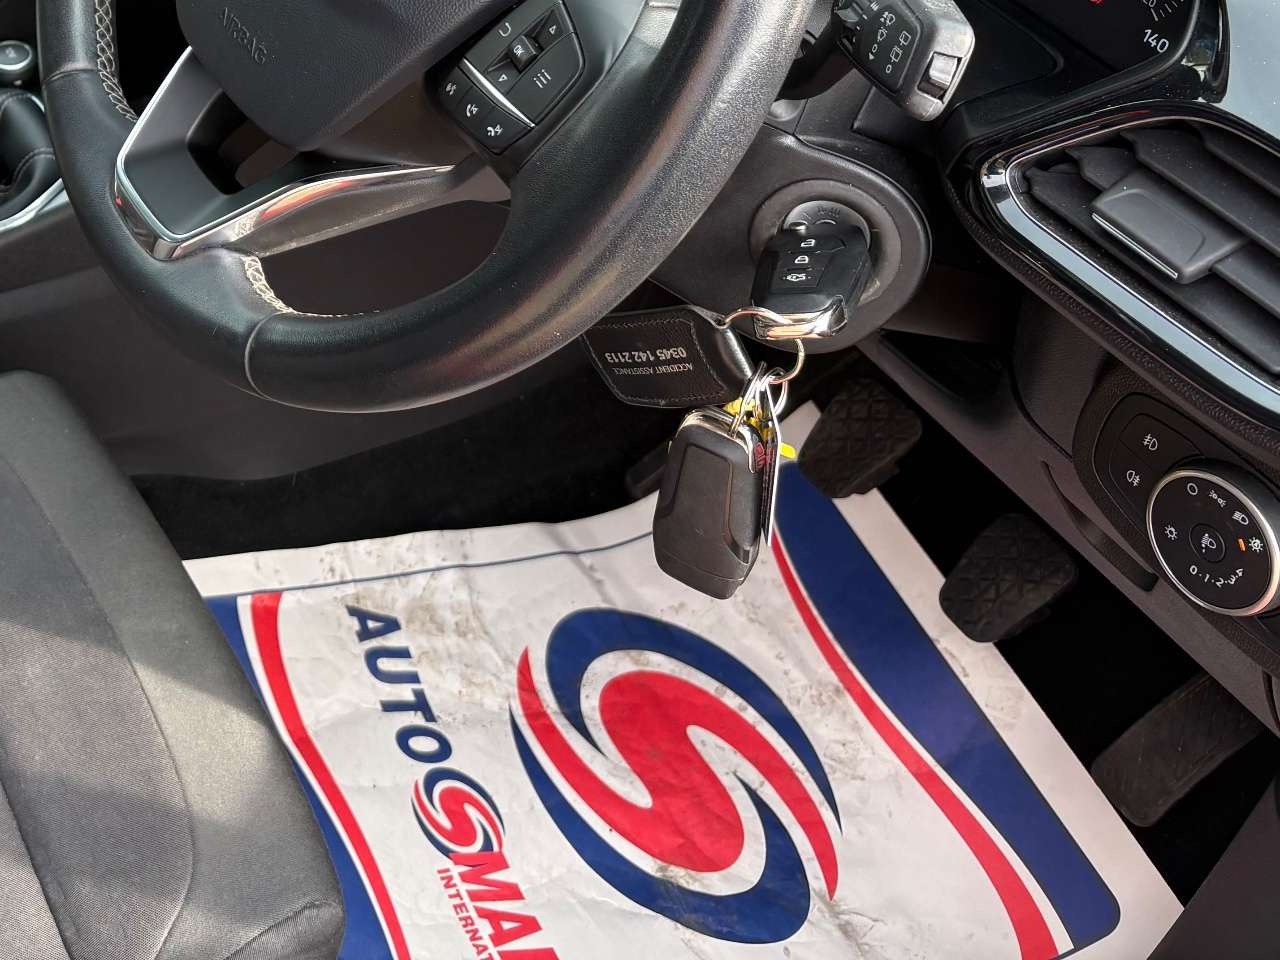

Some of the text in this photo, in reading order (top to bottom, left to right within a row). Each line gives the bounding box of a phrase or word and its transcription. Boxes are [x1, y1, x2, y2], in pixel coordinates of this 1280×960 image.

[1143, 28, 1170, 53] 140
[513, 44, 526, 58] OK
[604, 346, 687, 364] 0345 142 2113
[655, 363, 693, 374] ACCIDENT
